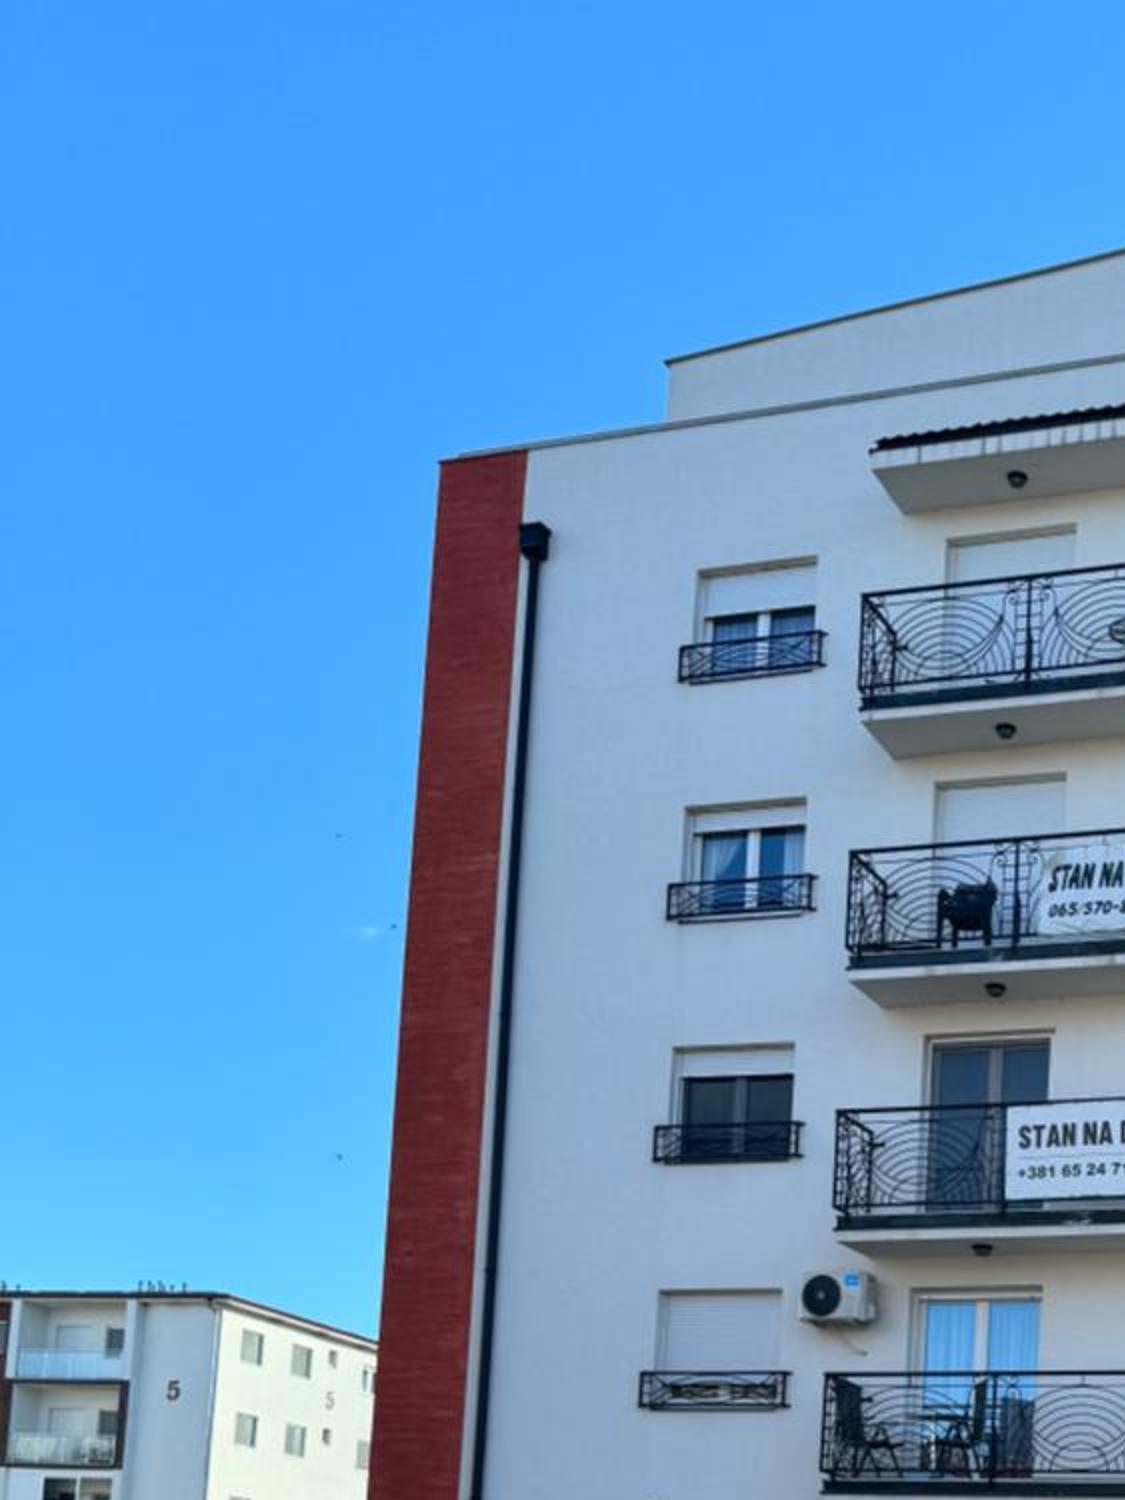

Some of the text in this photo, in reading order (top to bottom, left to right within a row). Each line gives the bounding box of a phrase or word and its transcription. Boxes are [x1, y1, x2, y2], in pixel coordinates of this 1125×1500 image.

[1048, 863, 1096, 892] STAN
[1098, 860, 1124, 888] NA
[1018, 1122, 1077, 1149] STAN
[1083, 1120, 1113, 1146] NA
[1018, 1165, 1055, 1181] +381
[1061, 1163, 1082, 1178] 65
[1086, 1161, 1106, 1177] 24
[166, 1379, 181, 1401] 5
[324, 1391, 336, 1411] 5
